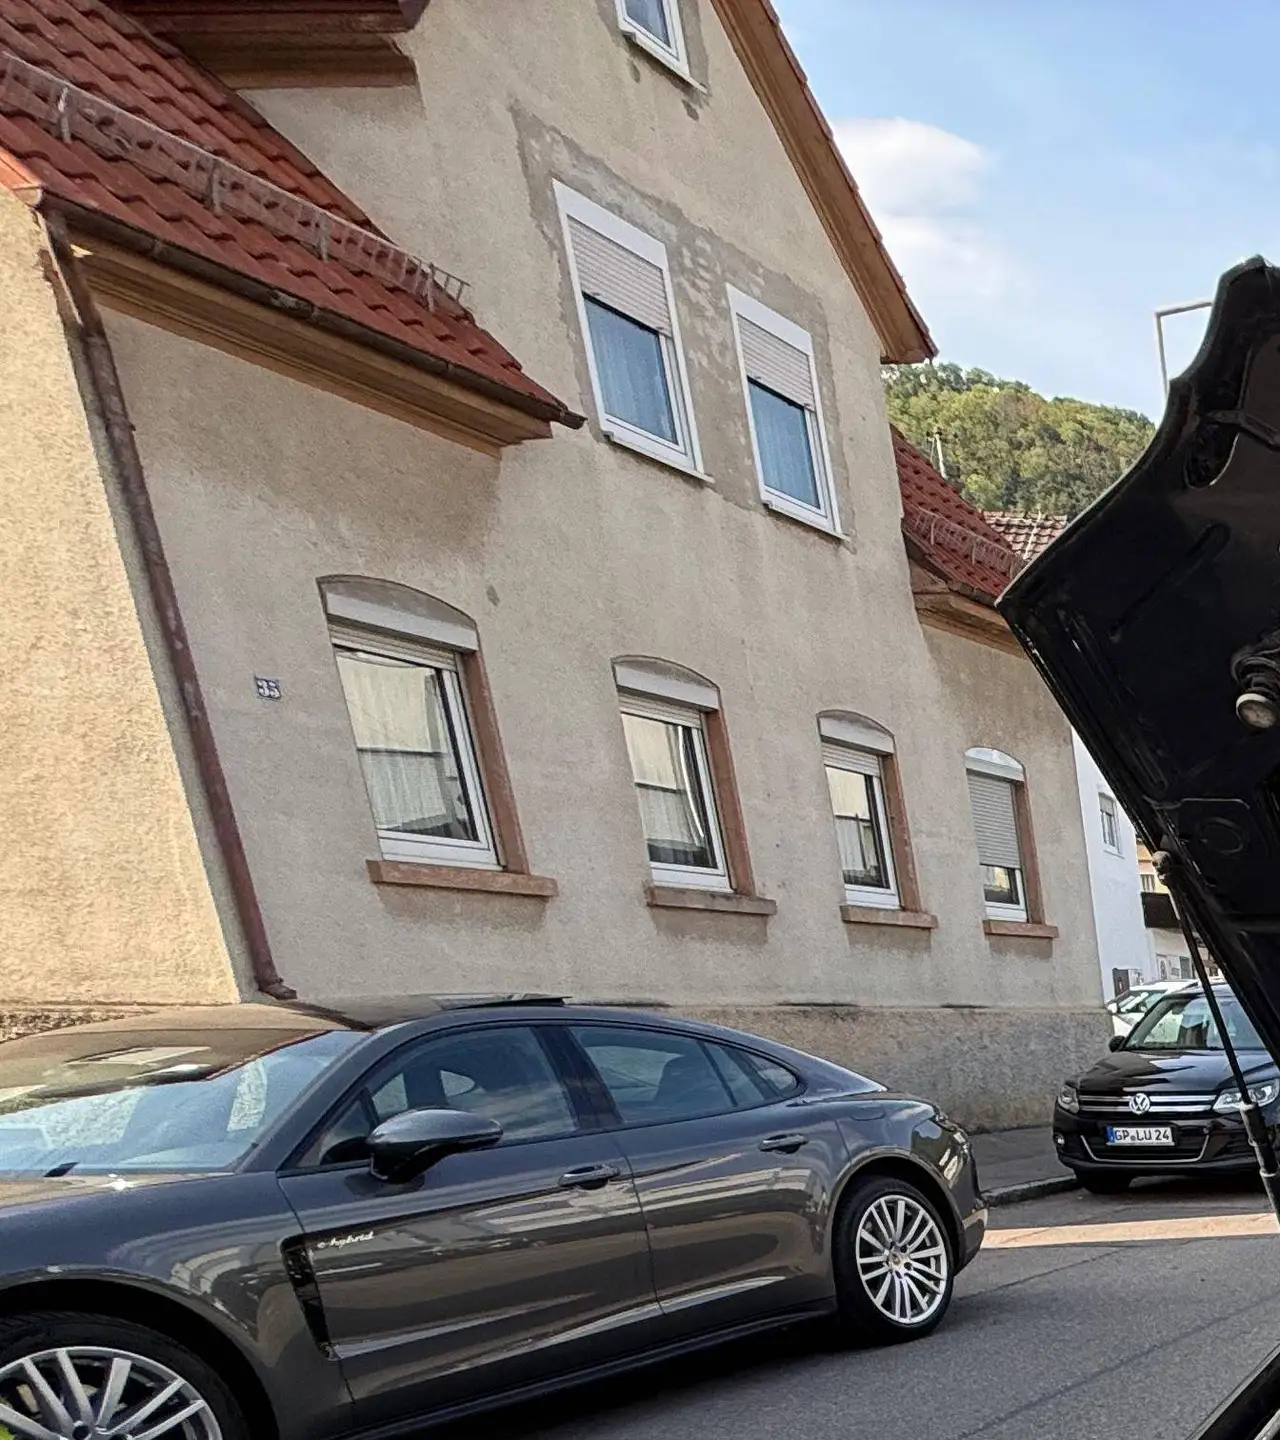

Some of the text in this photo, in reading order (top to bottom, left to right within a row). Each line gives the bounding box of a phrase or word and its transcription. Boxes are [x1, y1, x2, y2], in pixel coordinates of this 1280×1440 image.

[1114, 1129, 1170, 1141] GP LU 24
